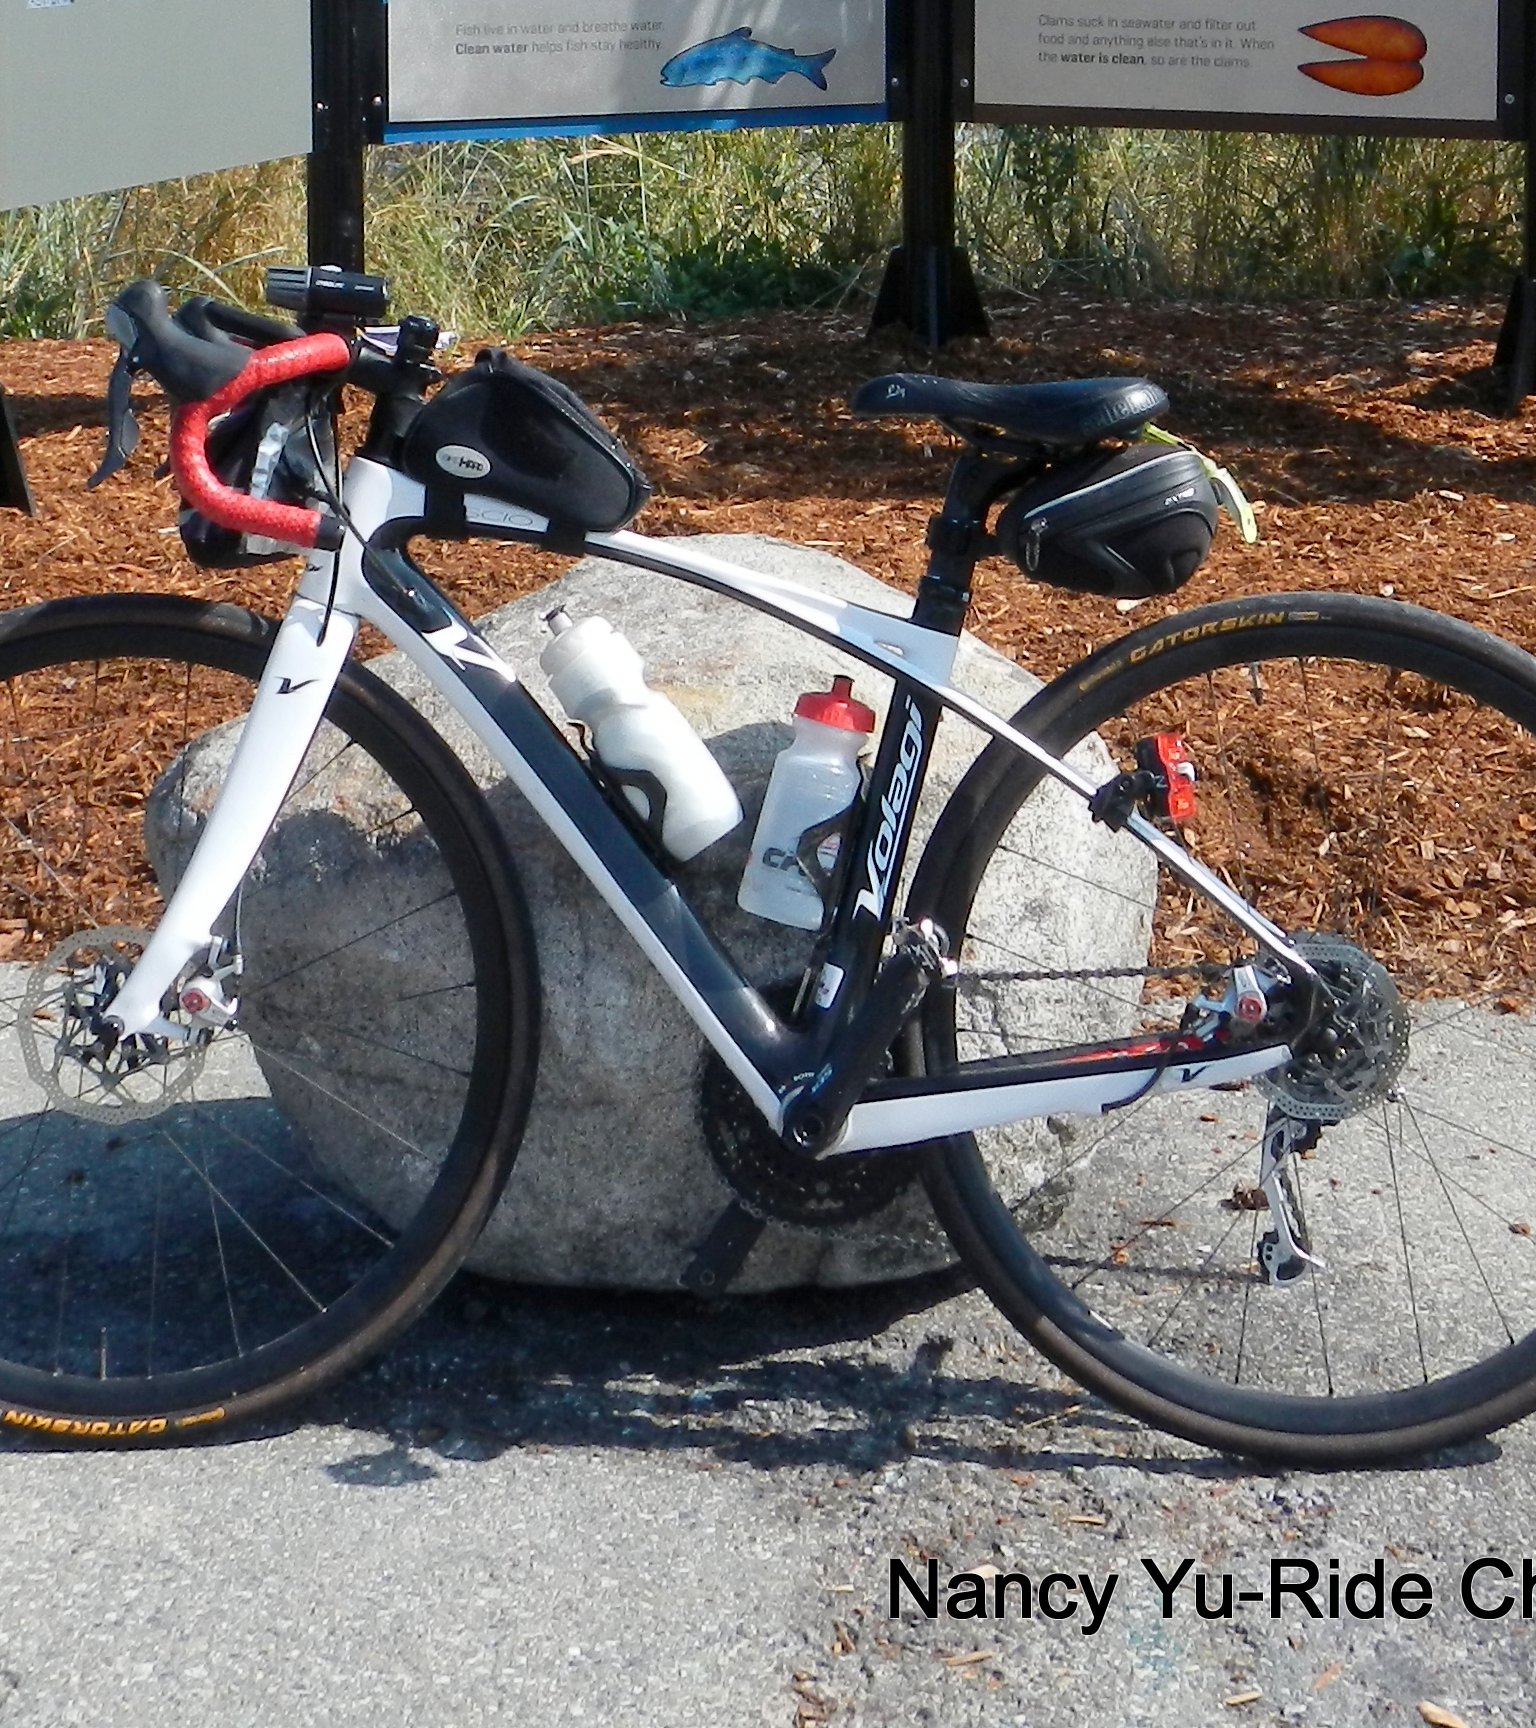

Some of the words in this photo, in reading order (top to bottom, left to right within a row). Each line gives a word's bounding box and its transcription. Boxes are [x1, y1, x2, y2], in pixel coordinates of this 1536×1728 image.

[455, 24, 480, 36] Fish
[507, 23, 518, 35] in
[521, 24, 553, 35] water
[558, 21, 579, 34] and
[582, 21, 627, 34] breathe
[1038, 14, 1074, 28] Clams
[1077, 15, 1104, 28] suck
[1107, 16, 1119, 28] in
[1121, 18, 1175, 30] seawater
[1179, 18, 1201, 30] and
[1204, 17, 1233, 31] filter
[1235, 20, 1256, 31] out
[455, 42, 490, 55] Clean
[492, 43, 529, 54] water
[531, 40, 563, 54] helps
[566, 40, 588, 52] fish
[591, 40, 615, 53] stay
[1037, 33, 1065, 45] food
[1067, 33, 1089, 46] and
[1092, 34, 1144, 50] anything
[1147, 35, 1171, 47] else
[1174, 35, 1208, 48] that's
[1211, 37, 1222, 49] in
[1240, 38, 1275, 50] When
[1038, 51, 1057, 63] the
[1061, 52, 1095, 64] water
[1098, 52, 1109, 64] is
[1150, 55, 1165, 66] so
[1168, 56, 1187, 66] are
[1191, 54, 1210, 66] the
[1129, 610, 1286, 665] GATORSKIN
[851, 694, 923, 922] Volagi
[3, 1409, 168, 1436] GATORSKIN
